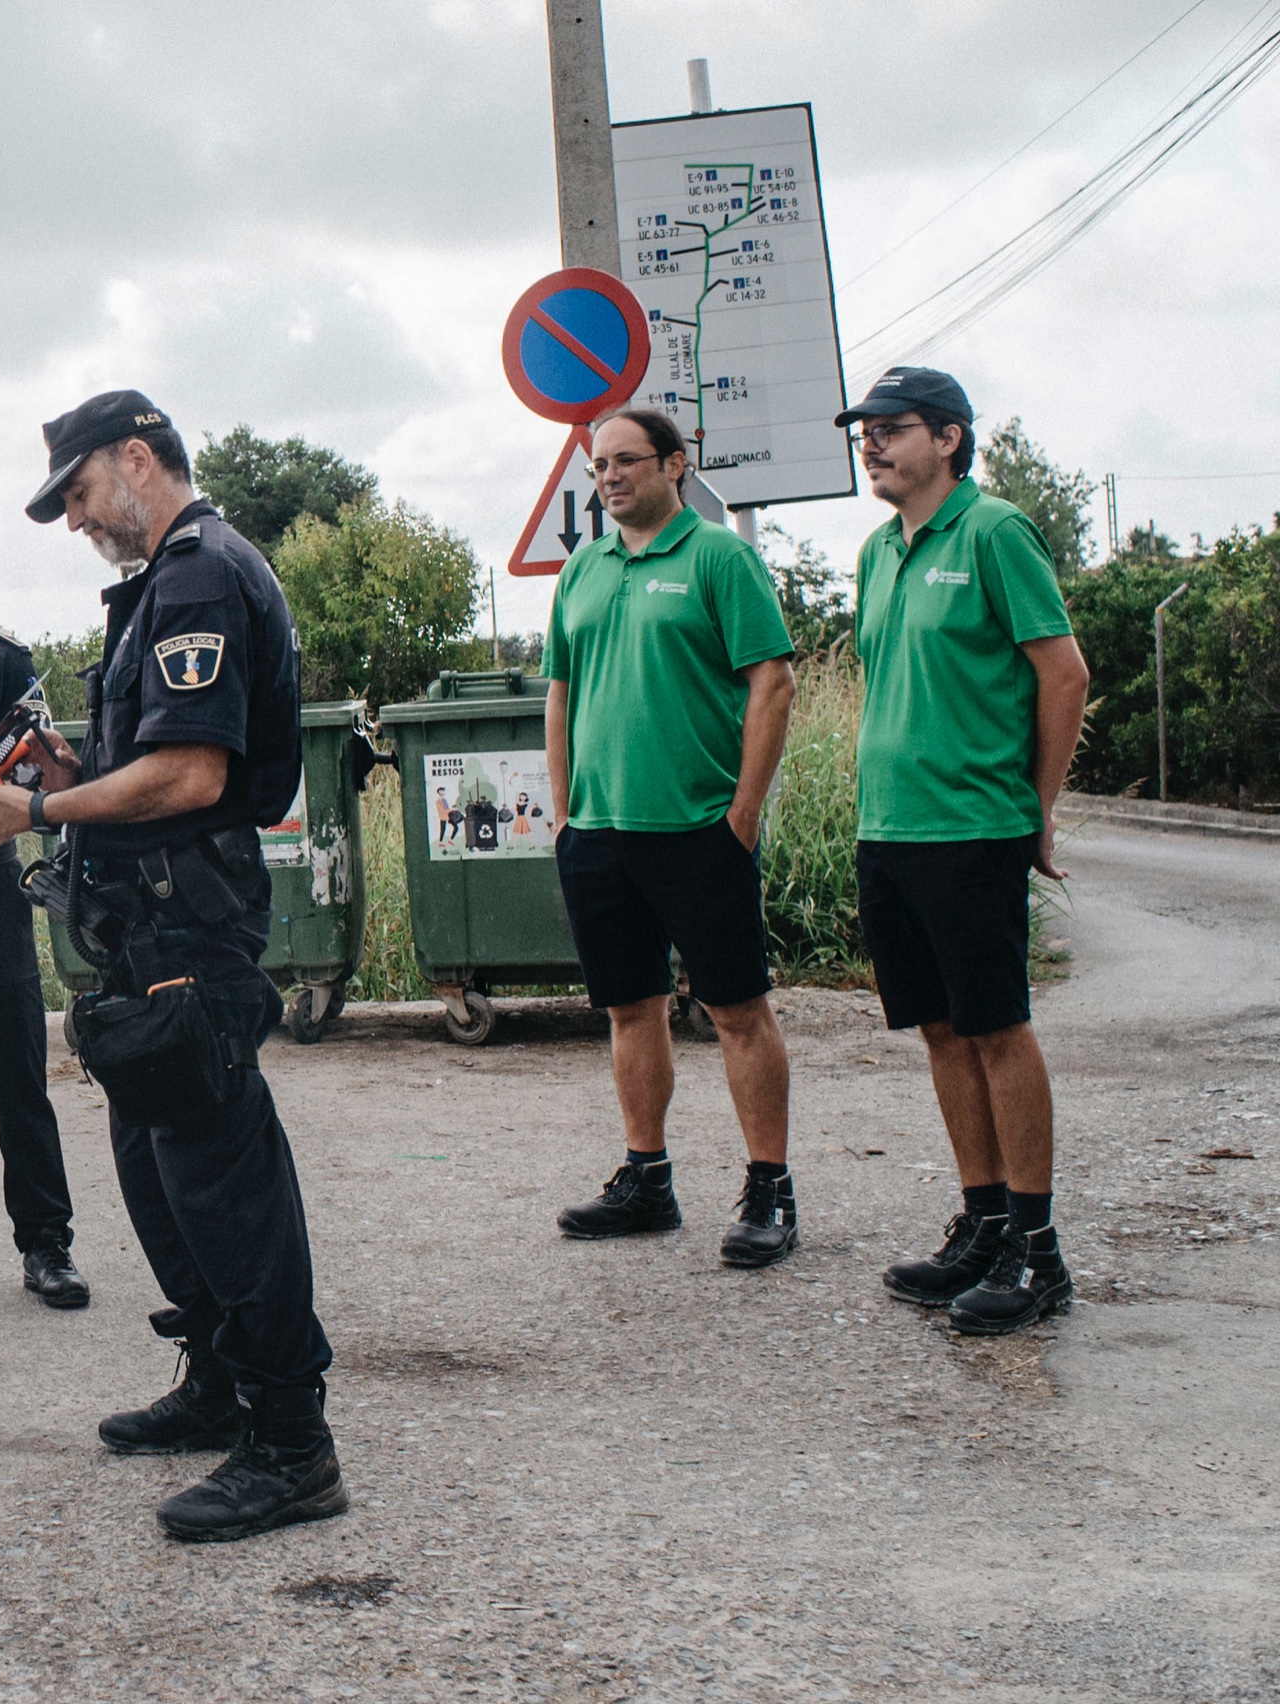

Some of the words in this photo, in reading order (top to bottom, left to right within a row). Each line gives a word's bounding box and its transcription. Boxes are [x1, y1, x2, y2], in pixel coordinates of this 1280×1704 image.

[688, 172, 703, 183] E-9
[775, 167, 794, 178] E-10
[689, 186, 702, 196] UC
[704, 183, 729, 194] 91-95
[753, 184, 766, 194] UC
[768, 181, 796, 193] 54-60
[688, 204, 700, 215] UC
[702, 201, 729, 213] 83-85
[782, 197, 798, 208] E-8
[637, 216, 652, 227] E-7
[757, 213, 769, 224] UC
[772, 210, 799, 222] 46-52
[638, 230, 651, 240] UC
[653, 227, 680, 239] 63-77
[754, 239, 770, 250] E-6
[638, 251, 653, 262] E-5
[731, 255, 744, 266] UC
[746, 252, 774, 264] 34-42
[639, 265, 651, 275] UC
[654, 262, 679, 274] 45-61
[745, 276, 761, 287] E-4
[725, 292, 738, 302] UC
[740, 289, 766, 300] 14-32
[667, 336, 678, 348] DE
[681, 333, 693, 369] COMARE
[668, 351, 680, 380] ULLAL
[684, 372, 695, 384] LA
[731, 376, 746, 387] E-2
[648, 393, 662, 404] E-1
[717, 392, 729, 402] UC
[732, 389, 748, 401] 2-4
[134, 413, 162, 426] PLCS
[192, 637, 216, 645] LOCAL
[432, 758, 463, 768] RESTES
[431, 768, 464, 777] RESTOS
